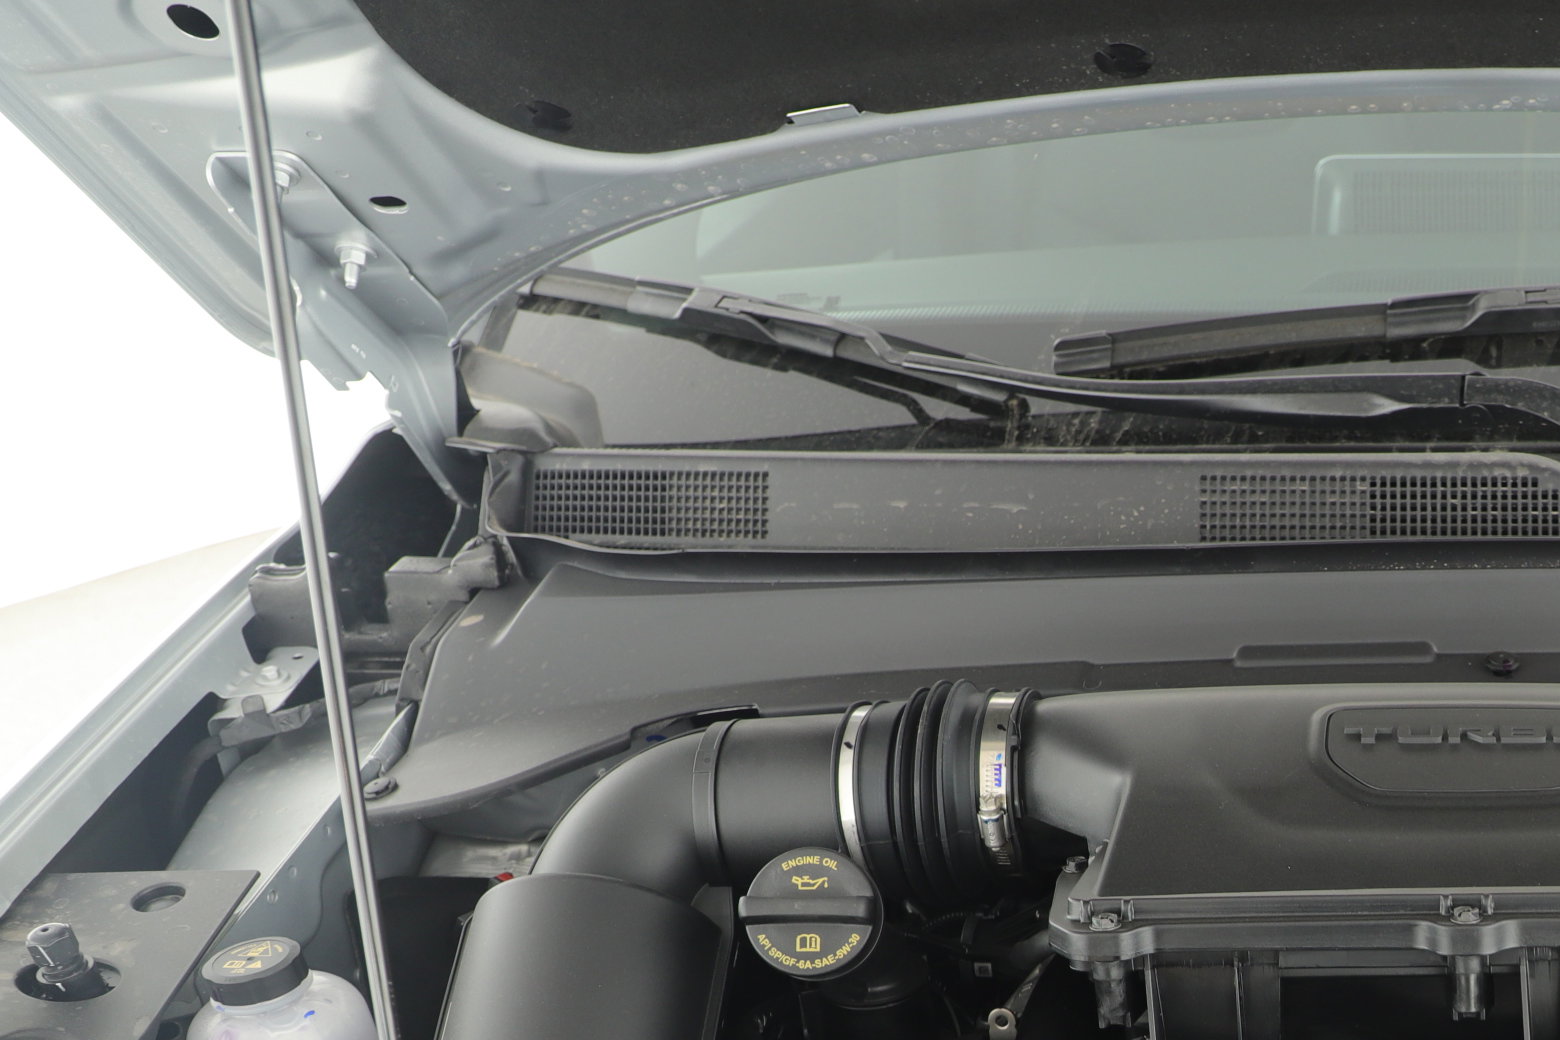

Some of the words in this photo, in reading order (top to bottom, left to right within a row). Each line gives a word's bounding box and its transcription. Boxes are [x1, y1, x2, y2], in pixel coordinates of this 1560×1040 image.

[781, 855, 820, 872] ENGINE
[823, 856, 838, 871] OIL
[757, 933, 771, 950] API
